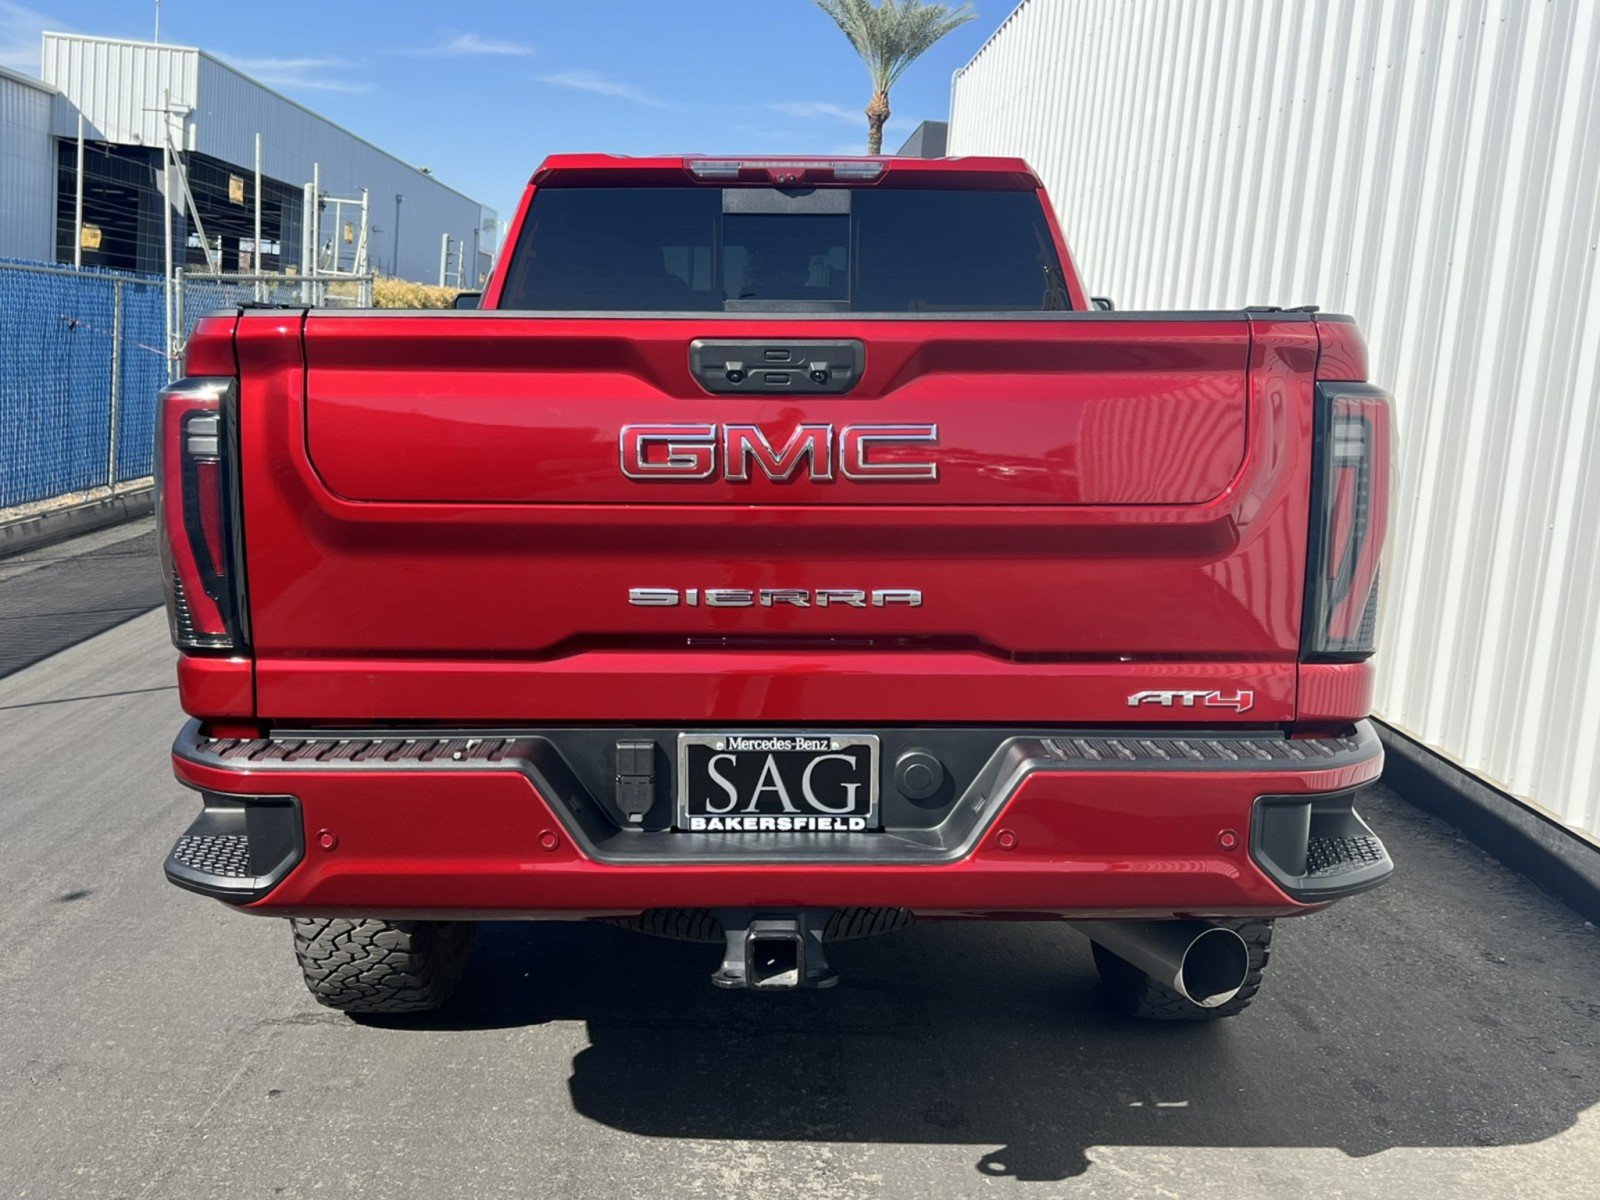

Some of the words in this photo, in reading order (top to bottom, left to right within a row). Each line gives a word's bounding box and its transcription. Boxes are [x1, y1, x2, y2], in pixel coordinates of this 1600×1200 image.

[620, 423, 937, 480] GMC
[629, 588, 922, 606] SIERRA
[1127, 690, 1254, 713] AT4
[728, 737, 828, 751] Mercedes-Benz
[705, 753, 862, 814] SAG
[690, 817, 866, 831] BAKERSFIELD
